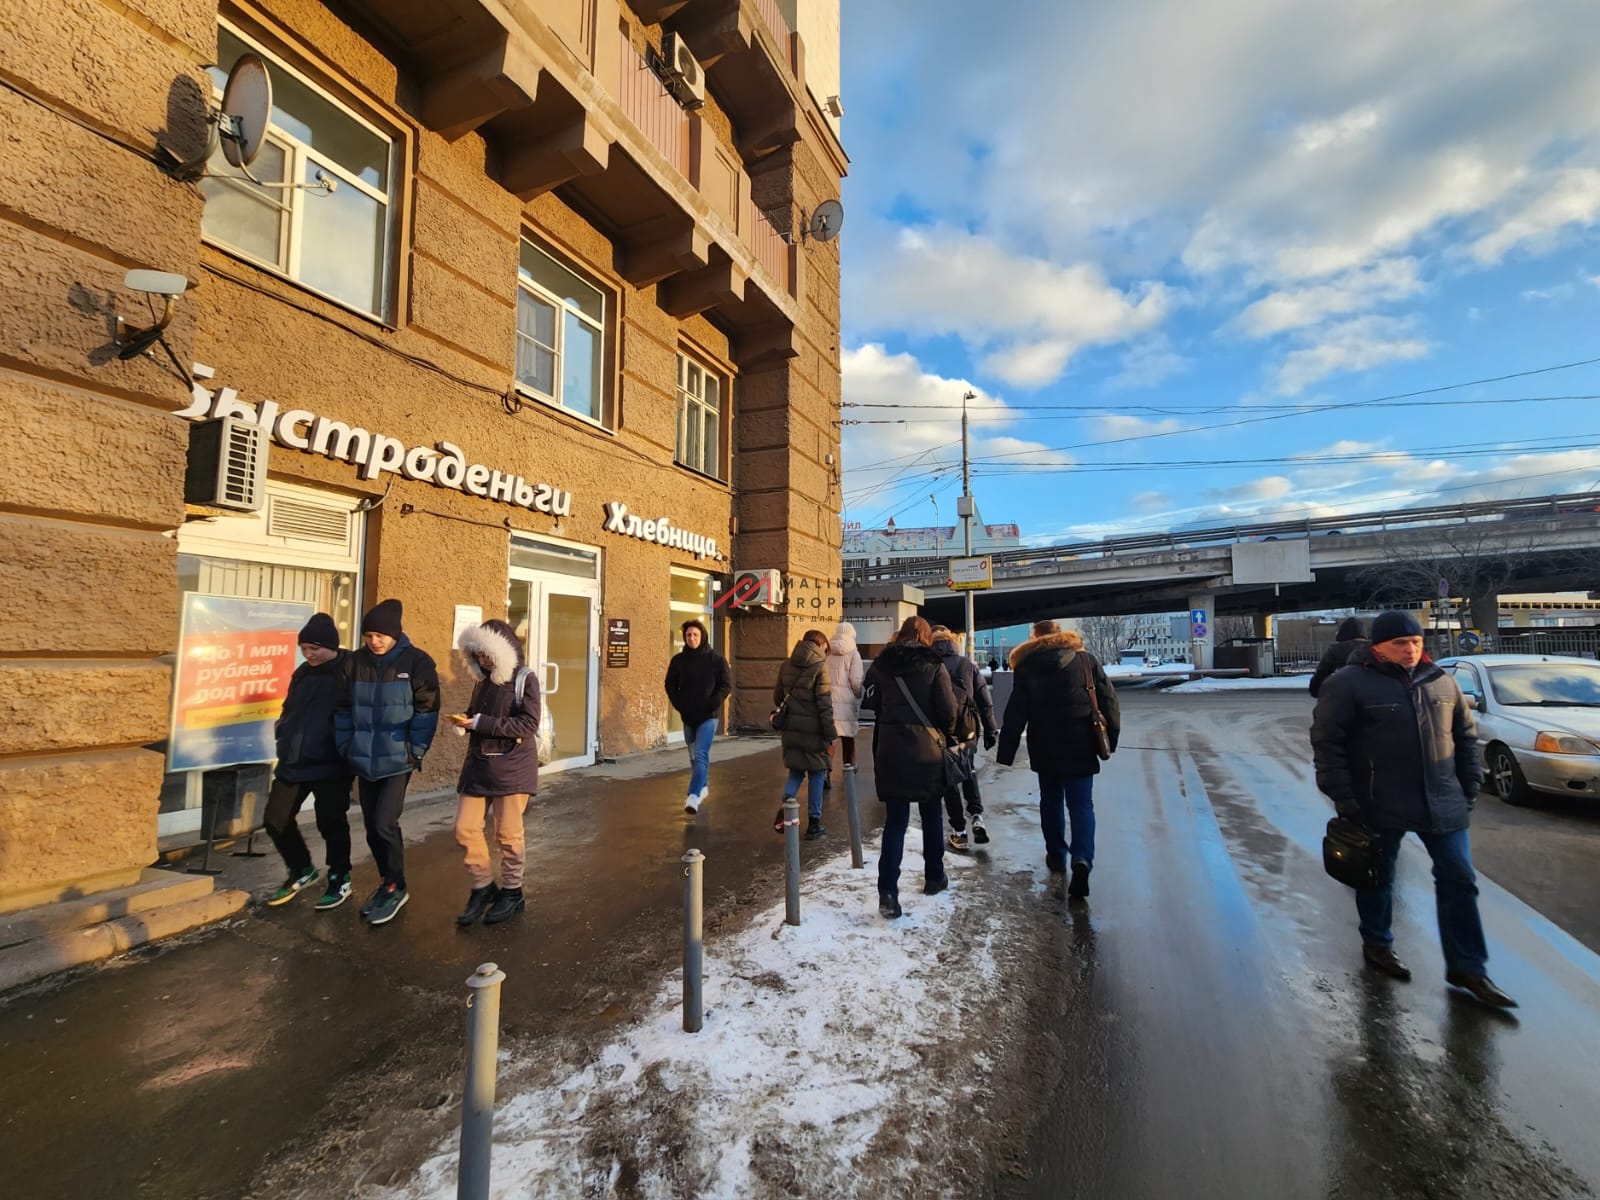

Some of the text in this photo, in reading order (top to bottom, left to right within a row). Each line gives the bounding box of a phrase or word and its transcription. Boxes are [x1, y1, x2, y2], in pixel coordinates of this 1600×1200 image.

[606, 501, 717, 560] Хлебница
[237, 643, 246, 659] 1
[250, 644, 289, 658] млн
[195, 659, 273, 686] рублей
[240, 677, 279, 697] ПТС
